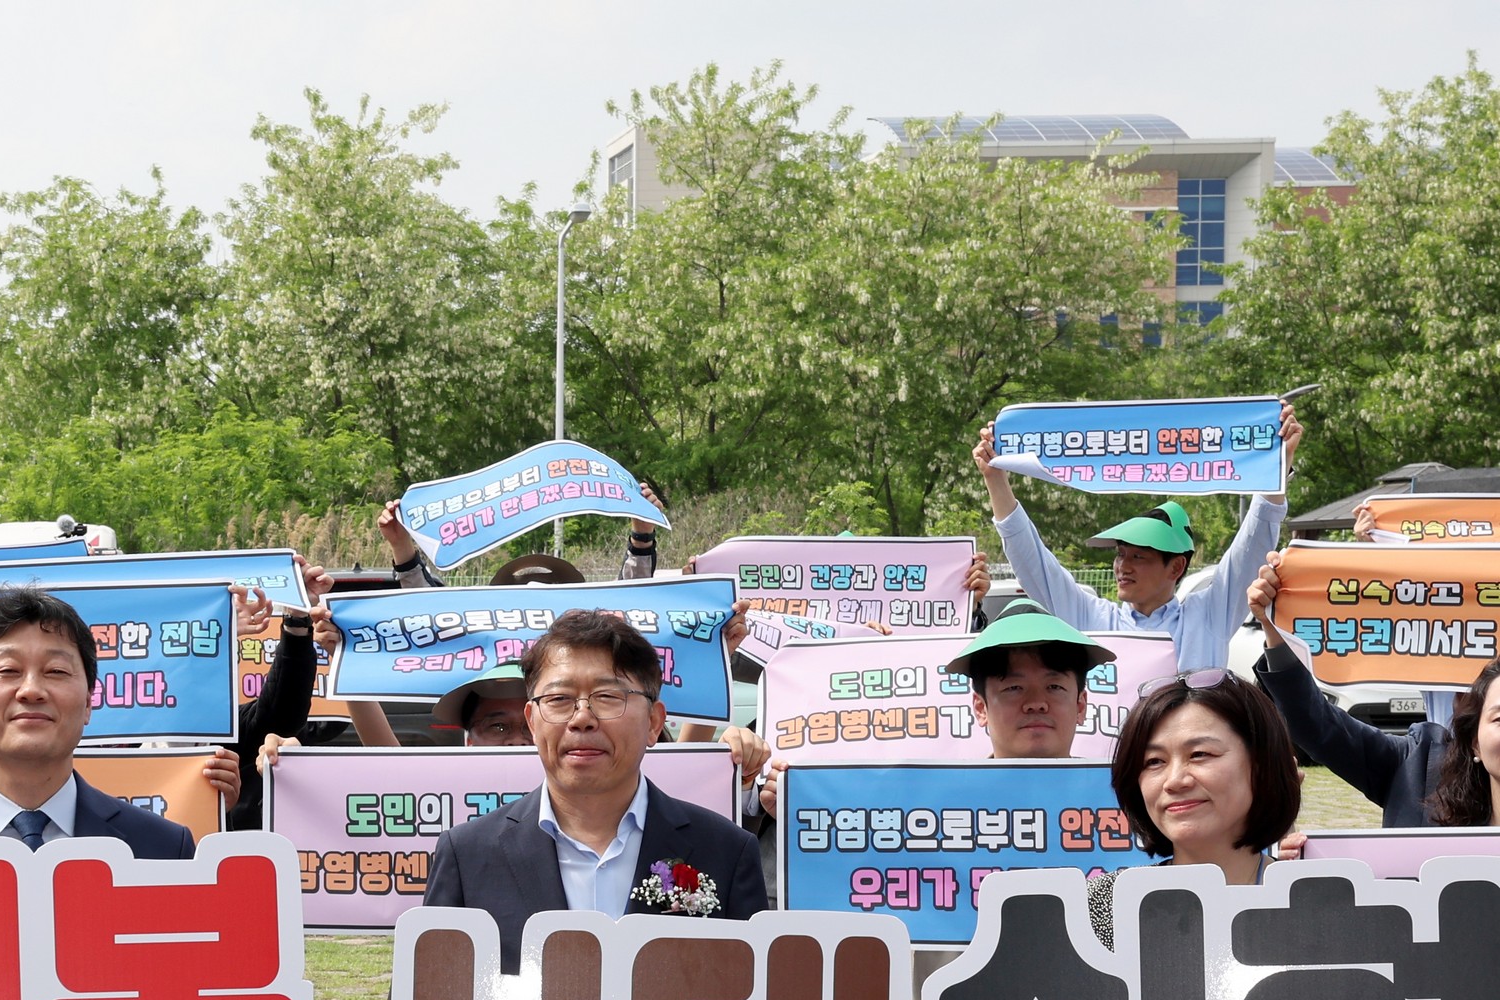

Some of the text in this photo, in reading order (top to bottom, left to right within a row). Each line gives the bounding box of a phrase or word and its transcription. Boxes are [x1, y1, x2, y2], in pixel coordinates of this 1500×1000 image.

[1156, 426, 1224, 455] 안전한
[1229, 424, 1276, 452] 전남
[1046, 459, 1242, 483] 리가 만들겠습니다.
[406, 465, 541, 531] 감염병으로부터
[546, 458, 609, 479] 안전한
[438, 481, 632, 546] 우리가 만들겠습니다.
[738, 564, 928, 592] 도민의 건강과 안전
[349, 608, 554, 653] 감염병으로부터
[665, 608, 726, 642] 전남
[889, 598, 961, 627] 합니다.
[159, 618, 223, 658] 전남
[392, 646, 488, 674] 우리가
[828, 666, 927, 701] 도민의
[776, 703, 975, 751] 감염병센터가
[346, 792, 455, 837] 도민의
[797, 807, 1145, 854] 감염병으로부터 안전
[849, 867, 961, 911] 우리가
